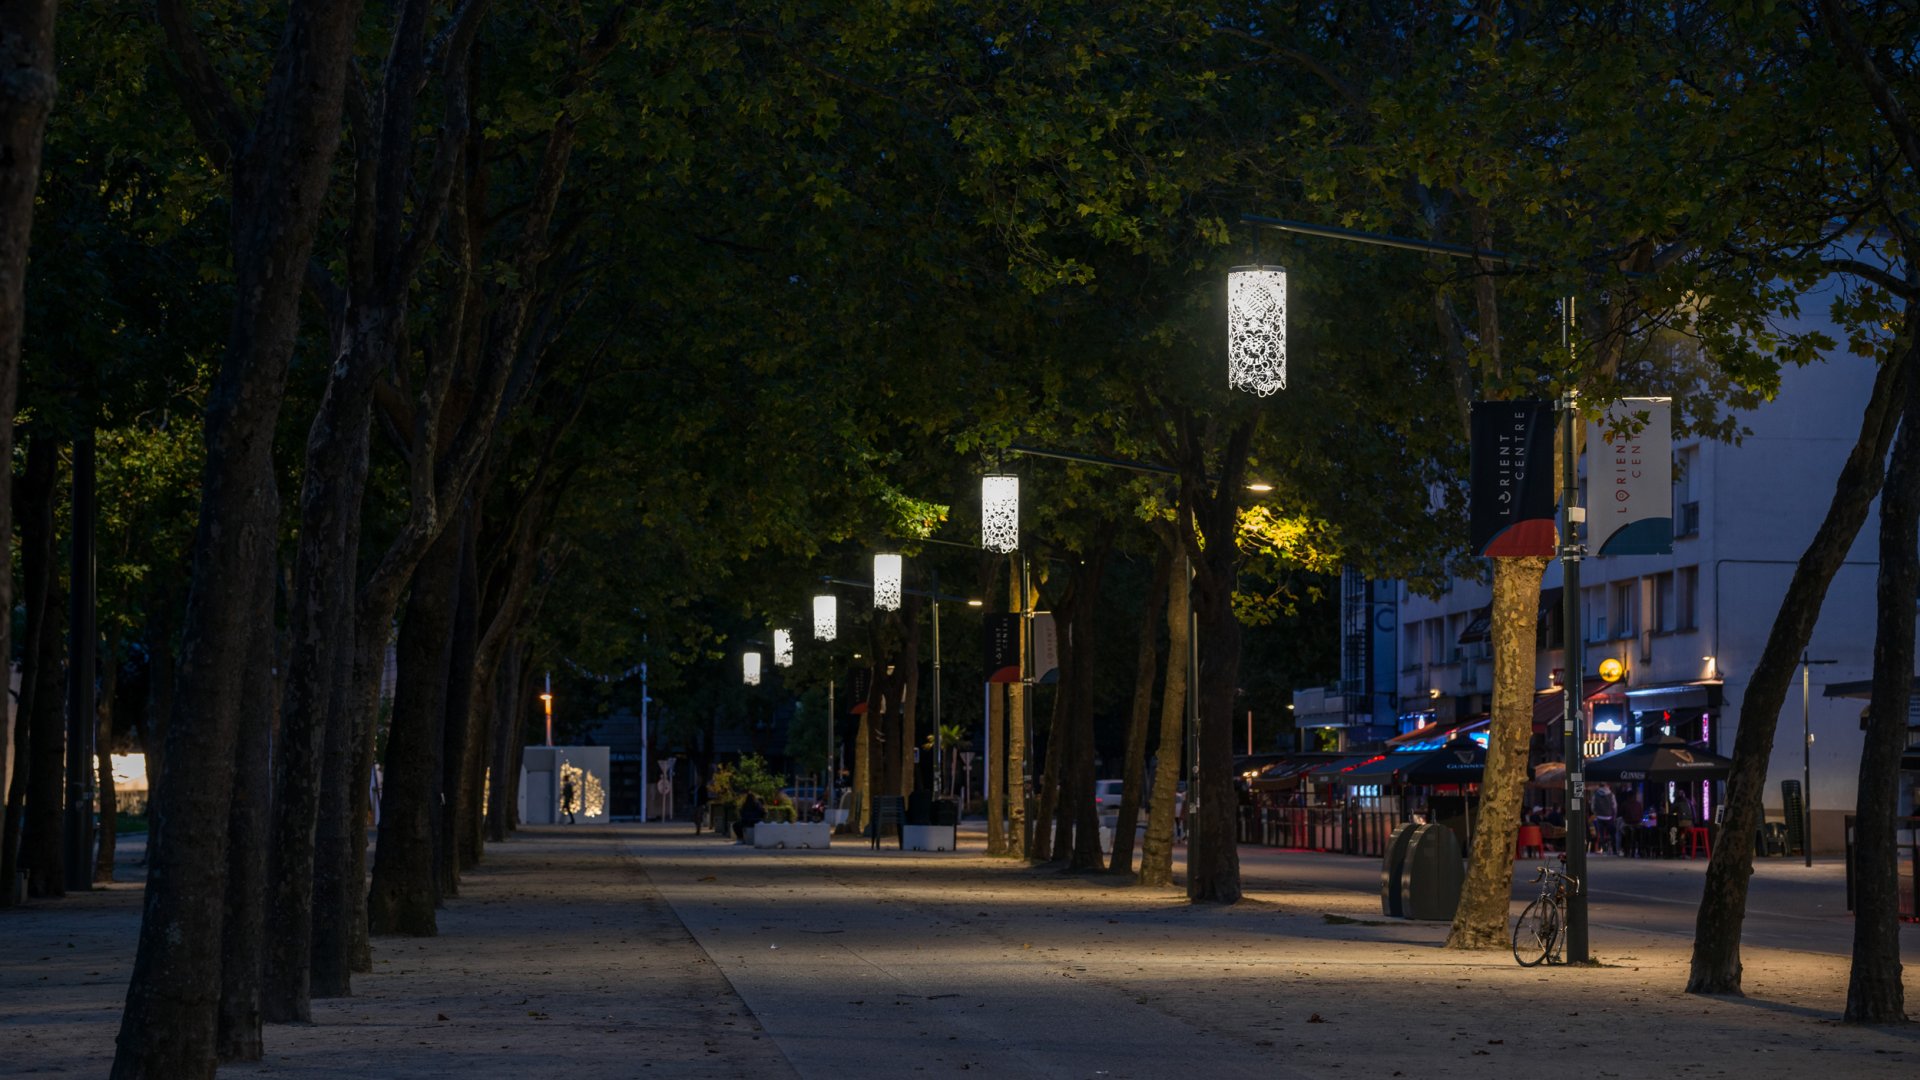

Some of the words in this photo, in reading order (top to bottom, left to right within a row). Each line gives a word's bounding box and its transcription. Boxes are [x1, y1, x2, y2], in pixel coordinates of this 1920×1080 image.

[1498, 434, 1512, 515] LORIENT
[1514, 411, 1525, 481] CENTRE
[1615, 434, 1630, 513] LORIENT
